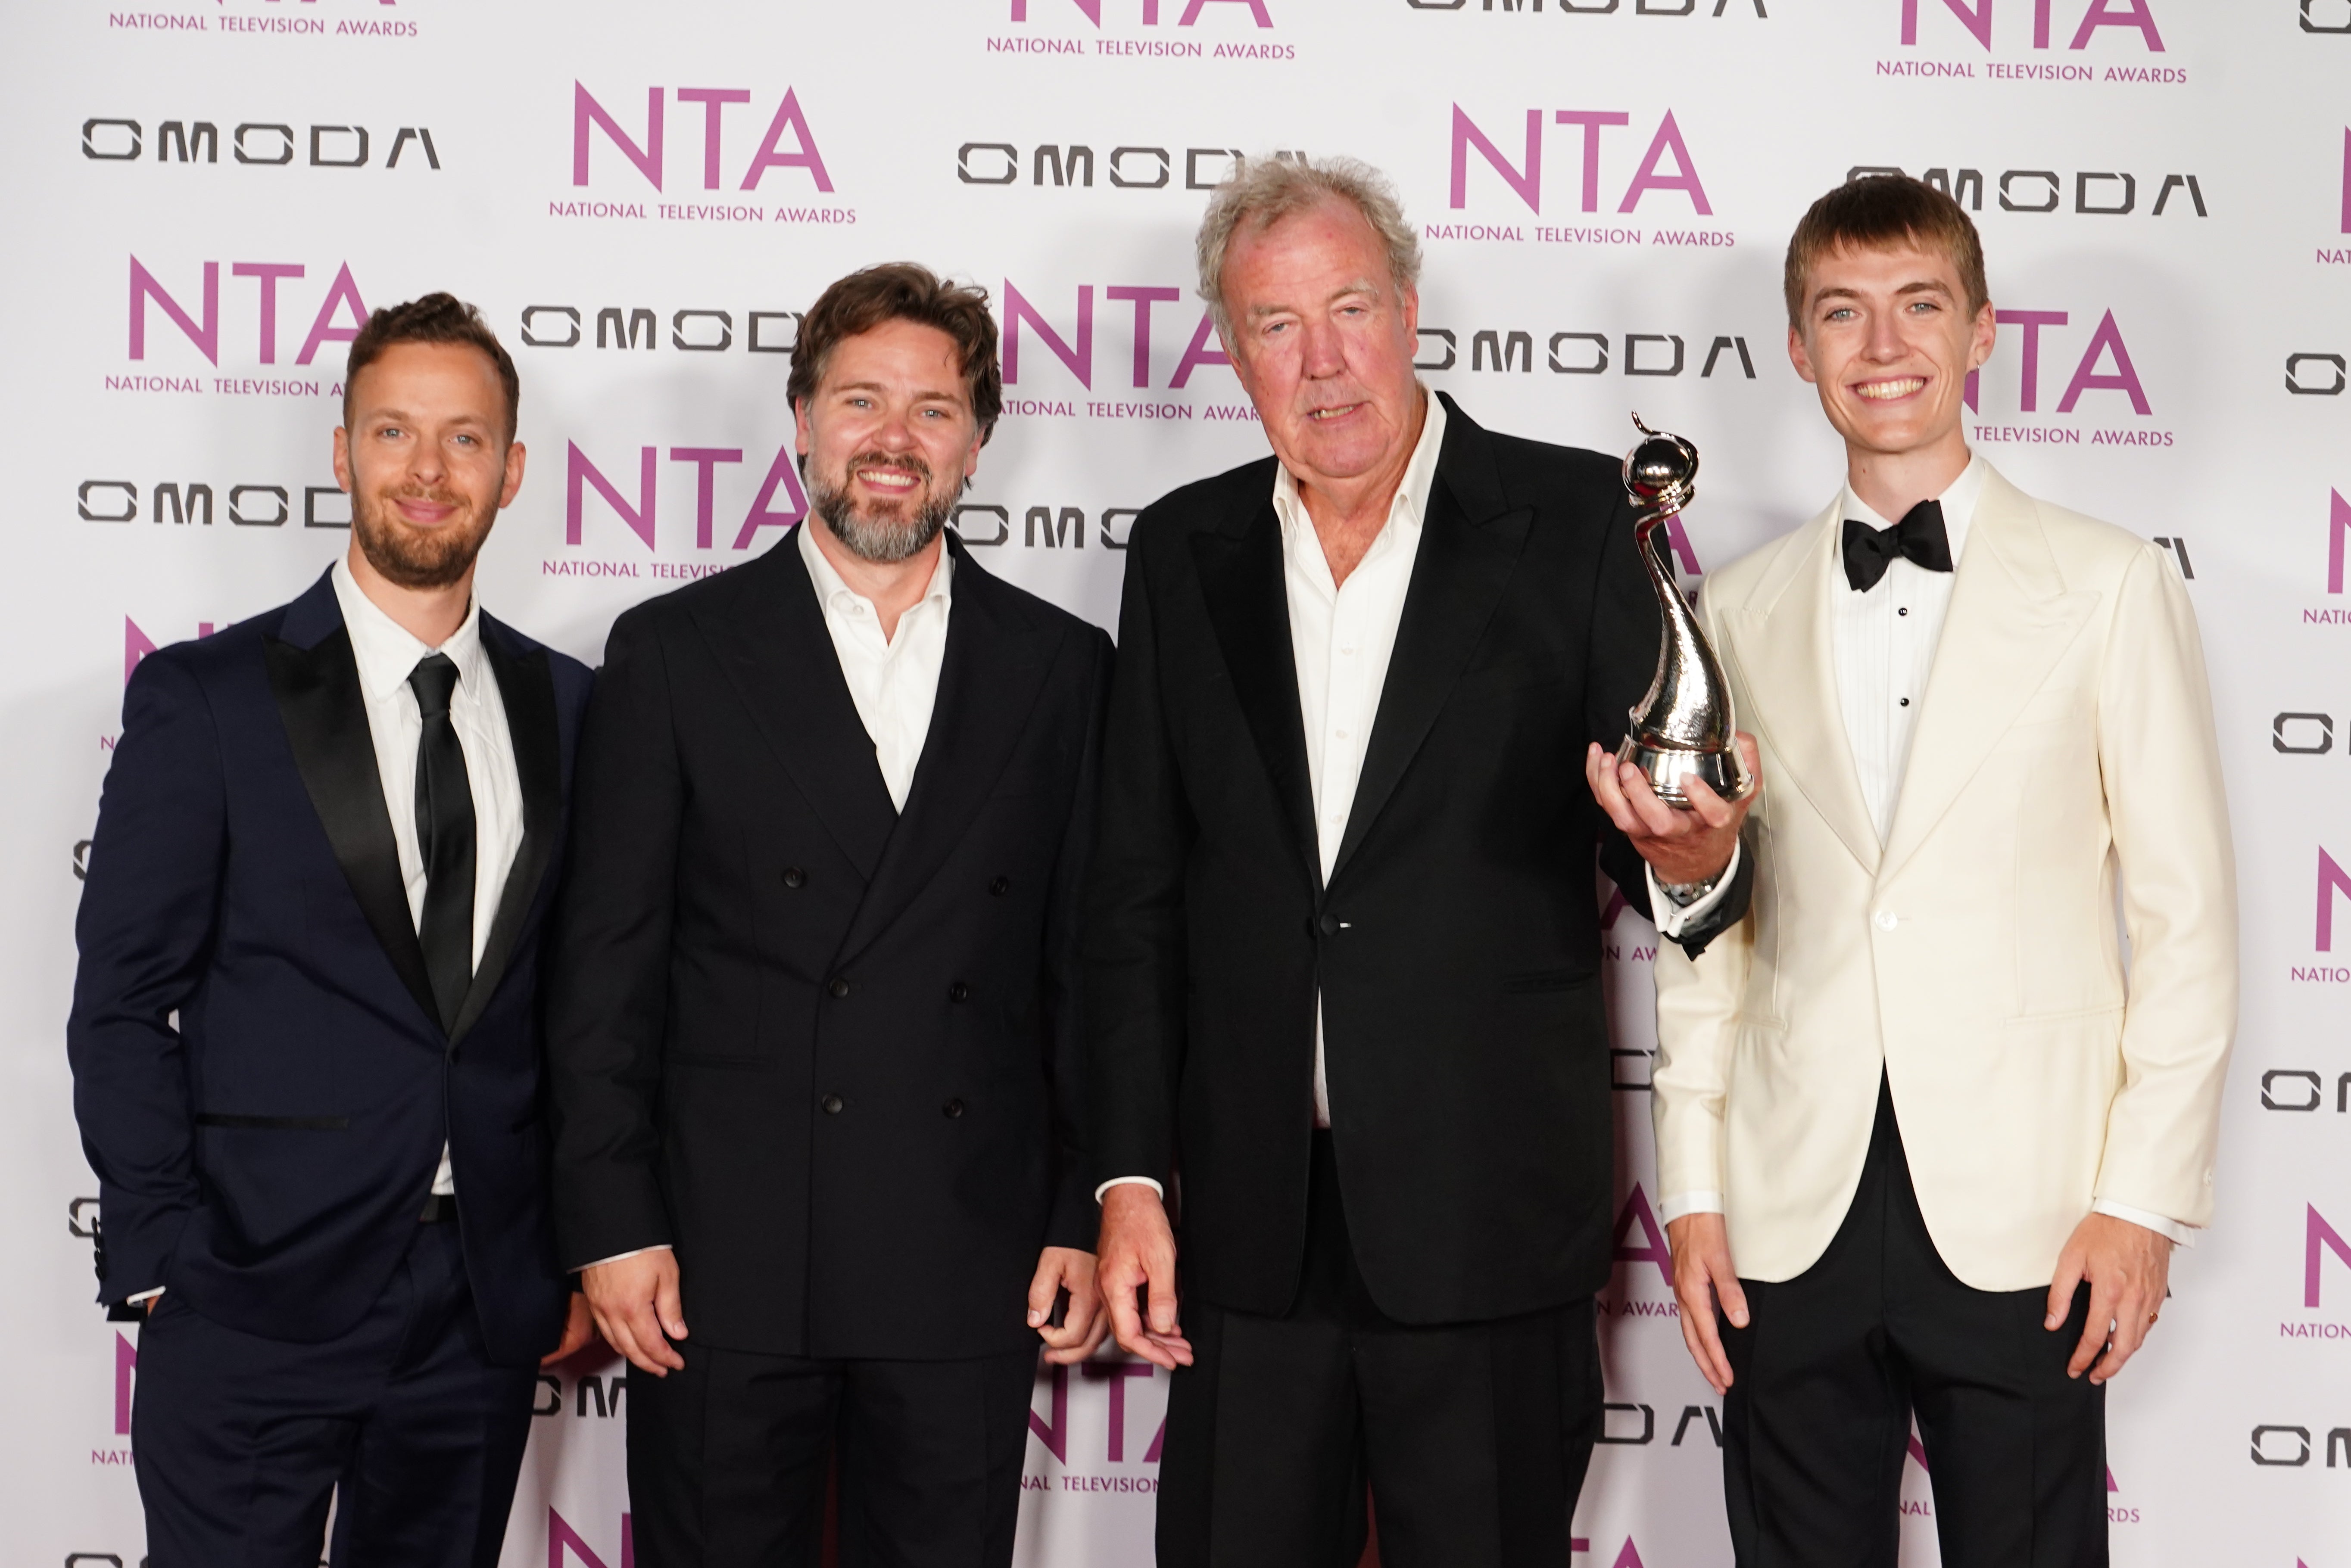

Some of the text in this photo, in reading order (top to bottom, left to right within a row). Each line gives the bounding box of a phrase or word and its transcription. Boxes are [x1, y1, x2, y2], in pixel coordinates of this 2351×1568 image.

[110, 14, 418, 36] NATIONAL TELEVISION AWARDS
[987, 38, 1295, 60] NATIONAL TELEVISION AWARDS
[1877, 61, 2186, 84] NATIONAL TELEVISION AWARDS
[82, 118, 441, 170] OMODA
[573, 78, 835, 194] NTA
[958, 142, 1308, 189] OMOD
[1450, 101, 1714, 216] NTA
[549, 202, 856, 224] NATIONAL TELEVISION AWARDS
[1426, 224, 1735, 247] NATIONAL TELEVISION AWARDS
[521, 305, 805, 352] OMOD
[1963, 308, 2153, 416] TA
[106, 376, 203, 393] NATIONAL
[215, 379, 318, 397] TELEVISION
[1088, 402, 1193, 420] TELEVISION
[1204, 405, 1260, 421] AWAR
[1974, 426, 2174, 447] TELEVISION AWARDS
[78, 480, 351, 528] OMOD
[949, 504, 1144, 550] OMO
[543, 561, 639, 577] NATIONAL
[1623, 1301, 1678, 1317] AWAR
